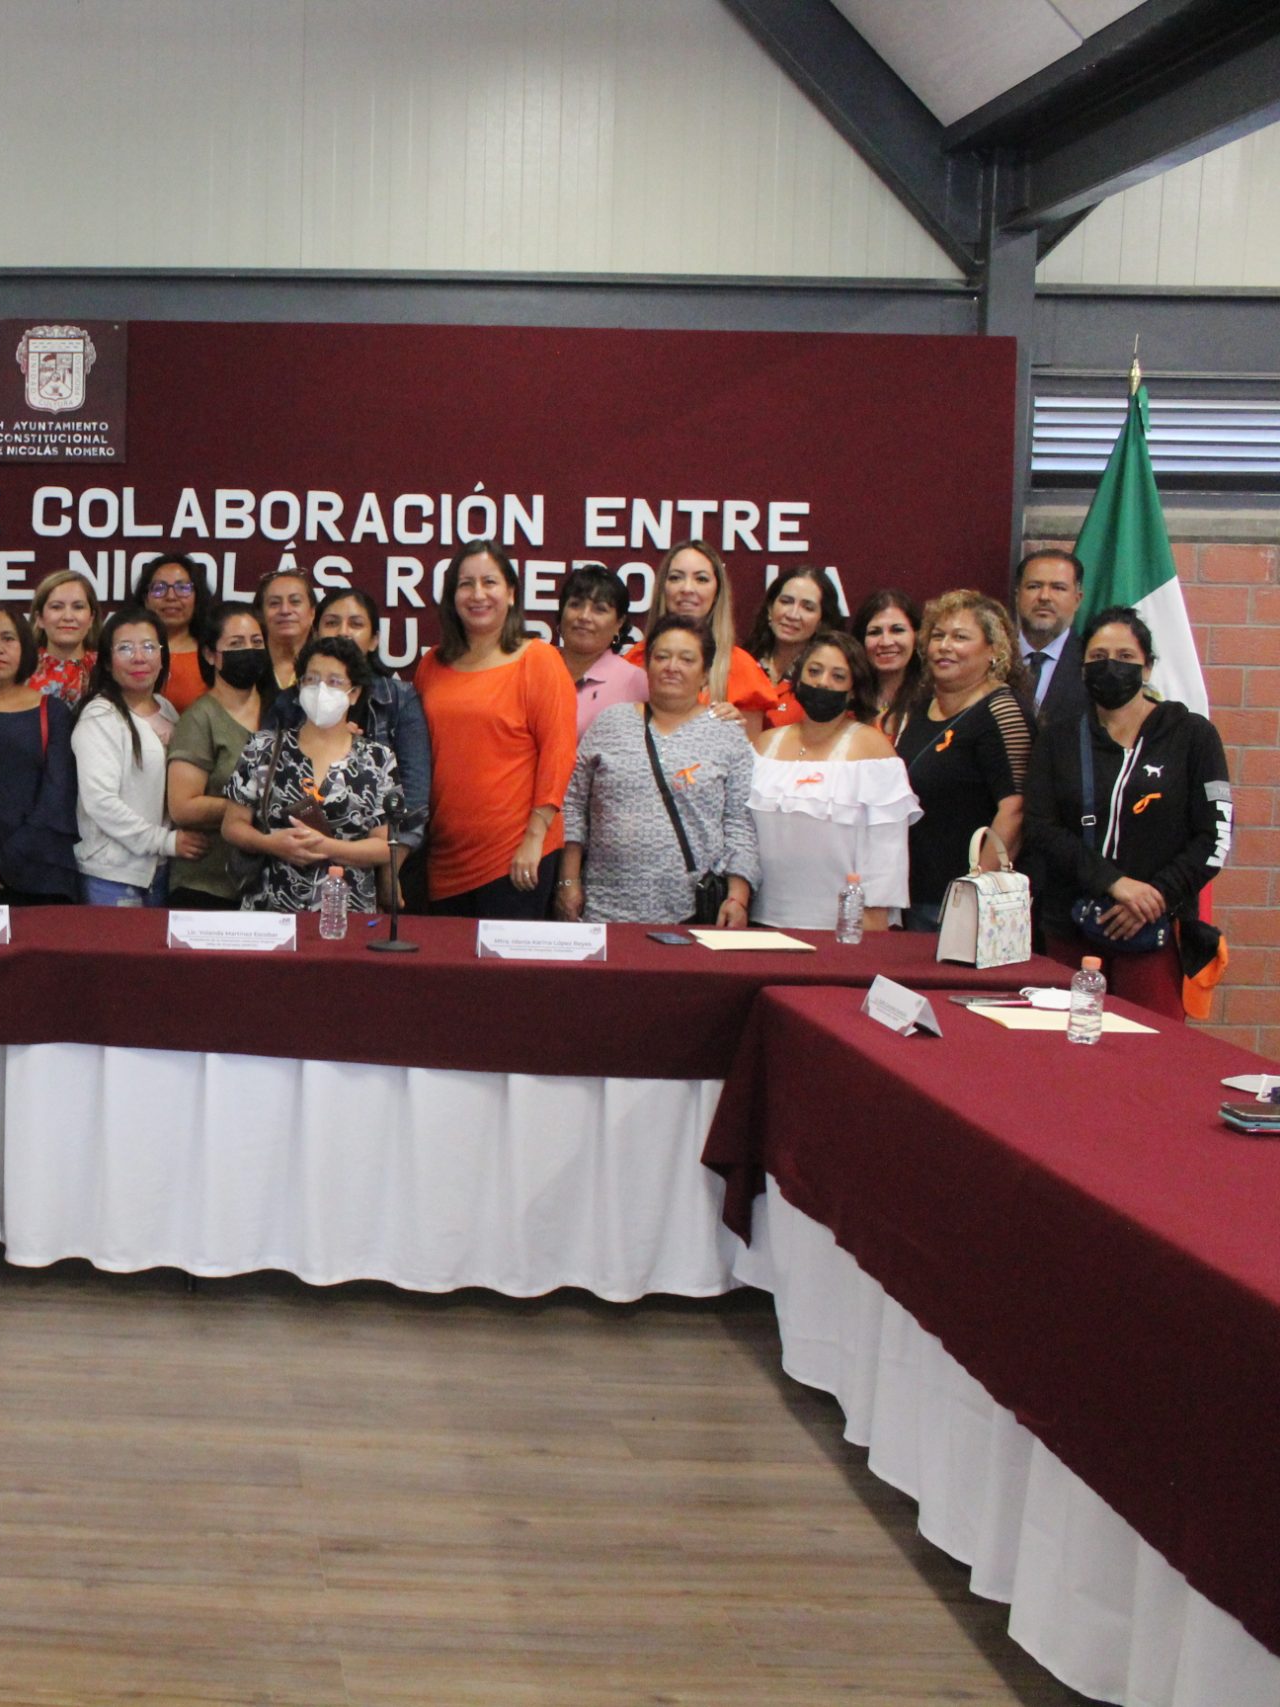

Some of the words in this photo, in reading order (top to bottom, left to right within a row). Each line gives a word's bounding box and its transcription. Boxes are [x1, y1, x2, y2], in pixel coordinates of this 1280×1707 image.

[13, 421, 109, 432] AYUNTAMIENTO
[6, 445, 59, 456] NICOLÁS
[65, 447, 115, 457] ROMERO
[31, 481, 545, 547] COLABORACIÓN
[584, 495, 811, 552] ENTRE
